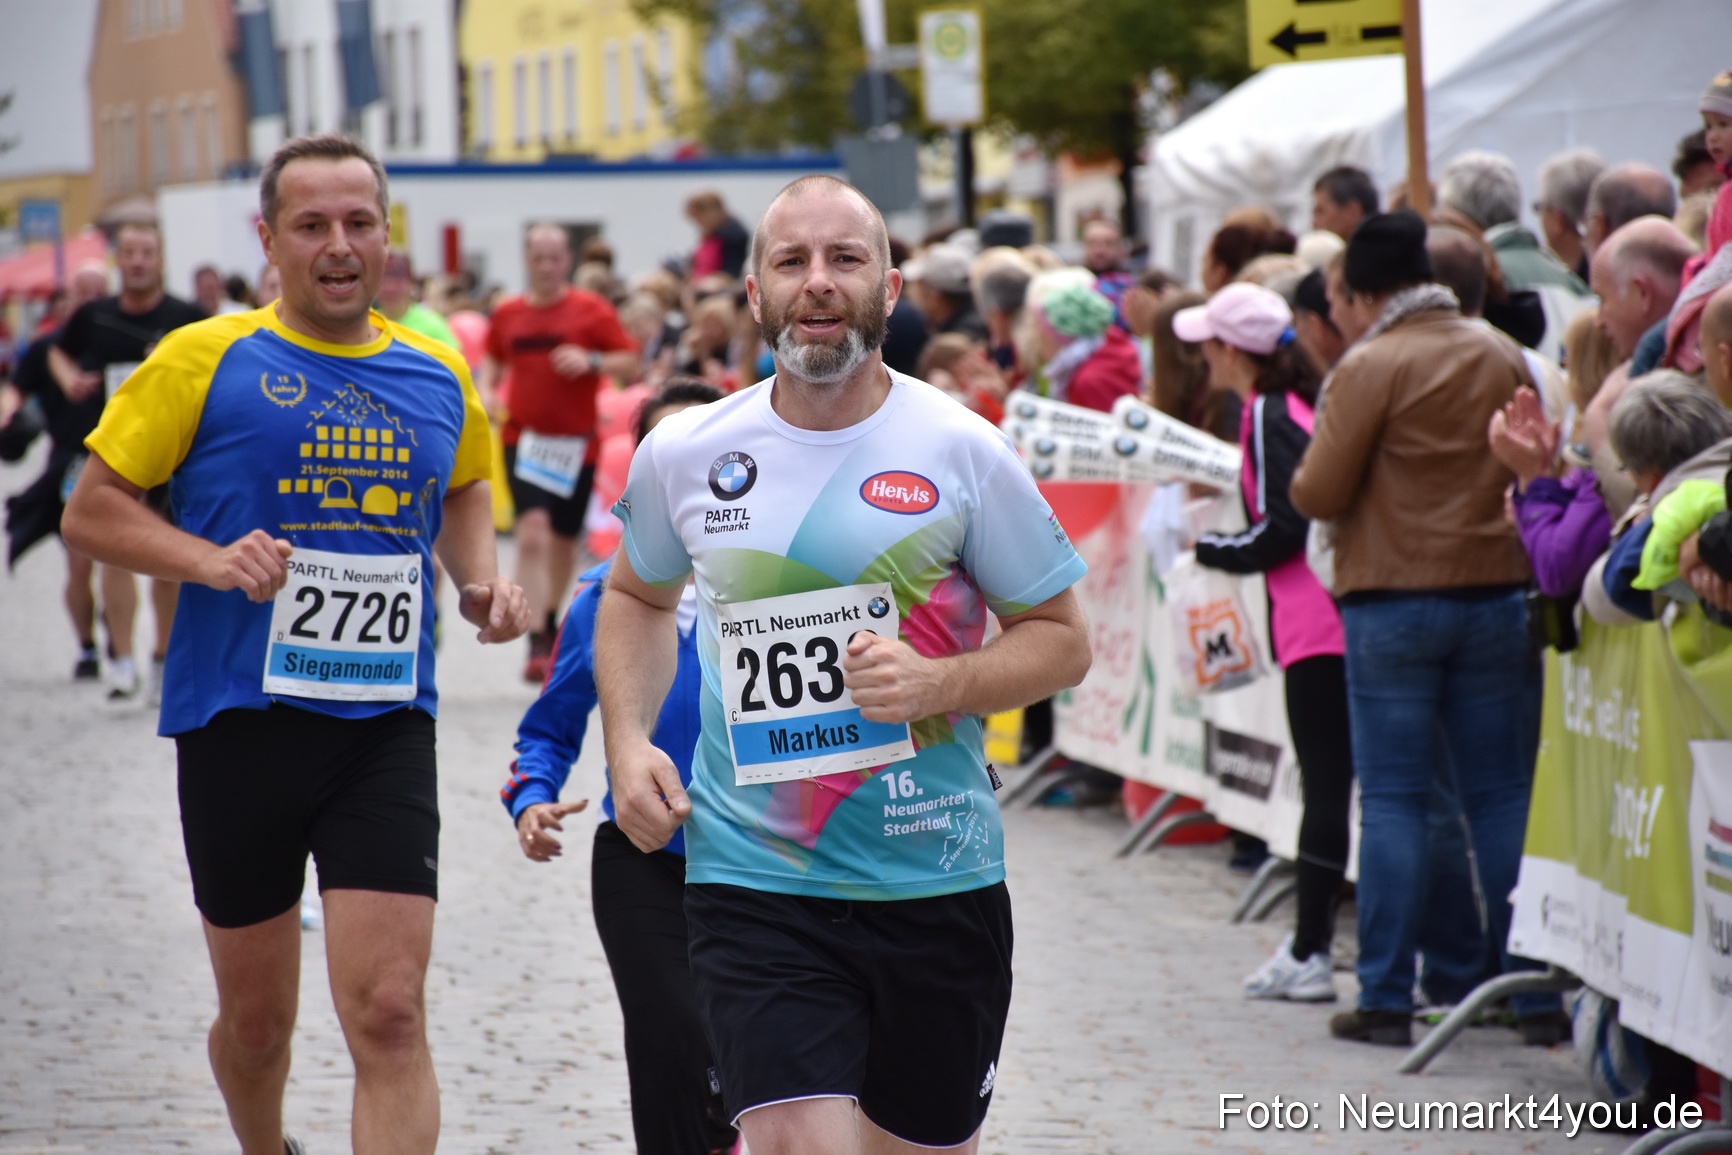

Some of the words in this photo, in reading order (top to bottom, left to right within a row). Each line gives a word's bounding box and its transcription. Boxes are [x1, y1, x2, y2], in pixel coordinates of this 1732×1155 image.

[272, 385, 299, 394] Jahre
[278, 375, 290, 384] 15
[381, 468, 409, 480] 2014
[712, 452, 755, 471] BMW
[871, 480, 930, 504] Hervis
[704, 522, 749, 535] Neumarkt
[705, 508, 751, 524] PARTL
[286, 560, 338, 581] PARTL
[343, 568, 405, 584] Neumarkt
[289, 585, 412, 645] 2726
[721, 619, 767, 638] PARTL
[770, 605, 861, 632] Neumarkt
[1206, 633, 1233, 663] M
[284, 651, 403, 682] Siegamondo
[736, 629, 879, 713] 263
[768, 723, 860, 755] Markus
[881, 770, 924, 800] 16.
[883, 792, 966, 818] Neumarkter
[883, 811, 952, 837] Stadtlauf
[943, 860, 954, 872] 20.
[949, 828, 971, 862] September
[968, 812, 980, 829] 2015
